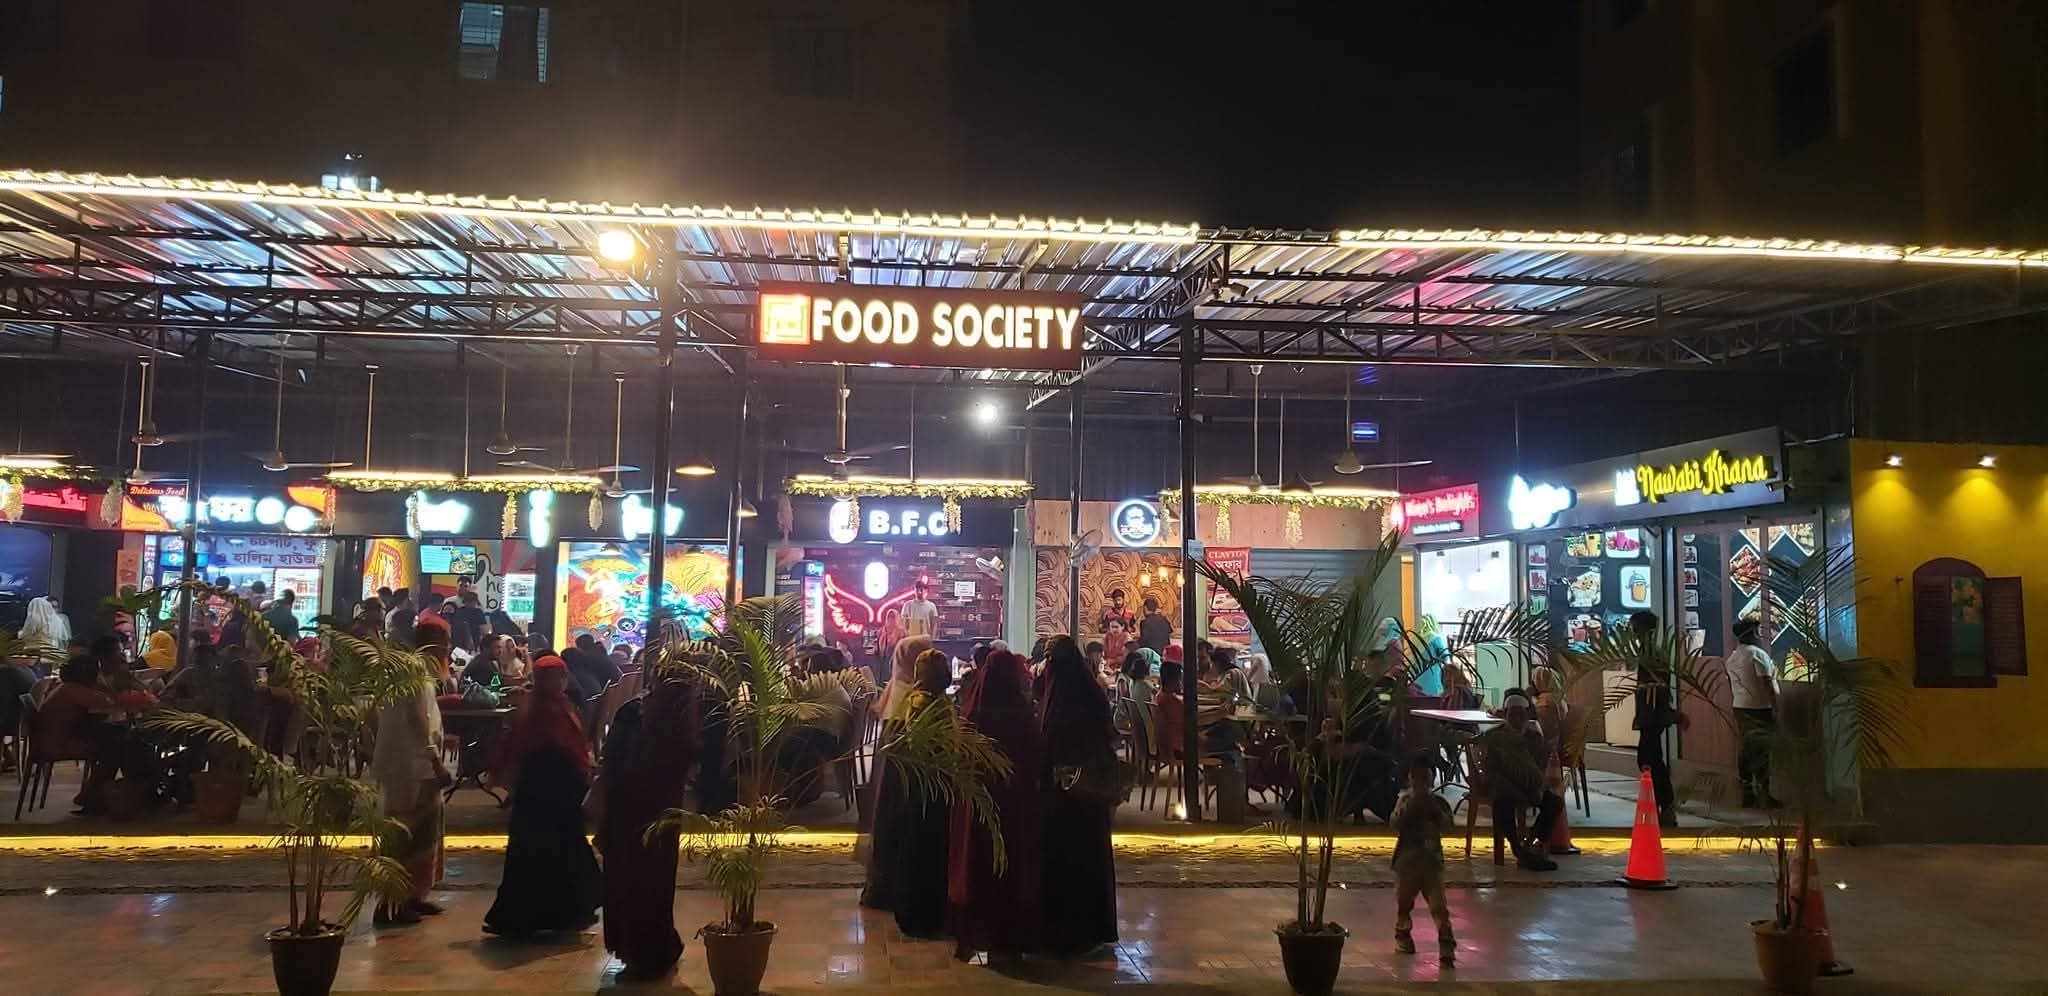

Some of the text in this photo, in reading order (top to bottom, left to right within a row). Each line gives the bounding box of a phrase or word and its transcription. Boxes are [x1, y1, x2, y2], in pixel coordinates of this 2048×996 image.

[813, 299, 1080, 349] FOOD SOCIETY
[130, 486, 164, 495] Delicious
[1637, 449, 1768, 503] Nawabi Khana
